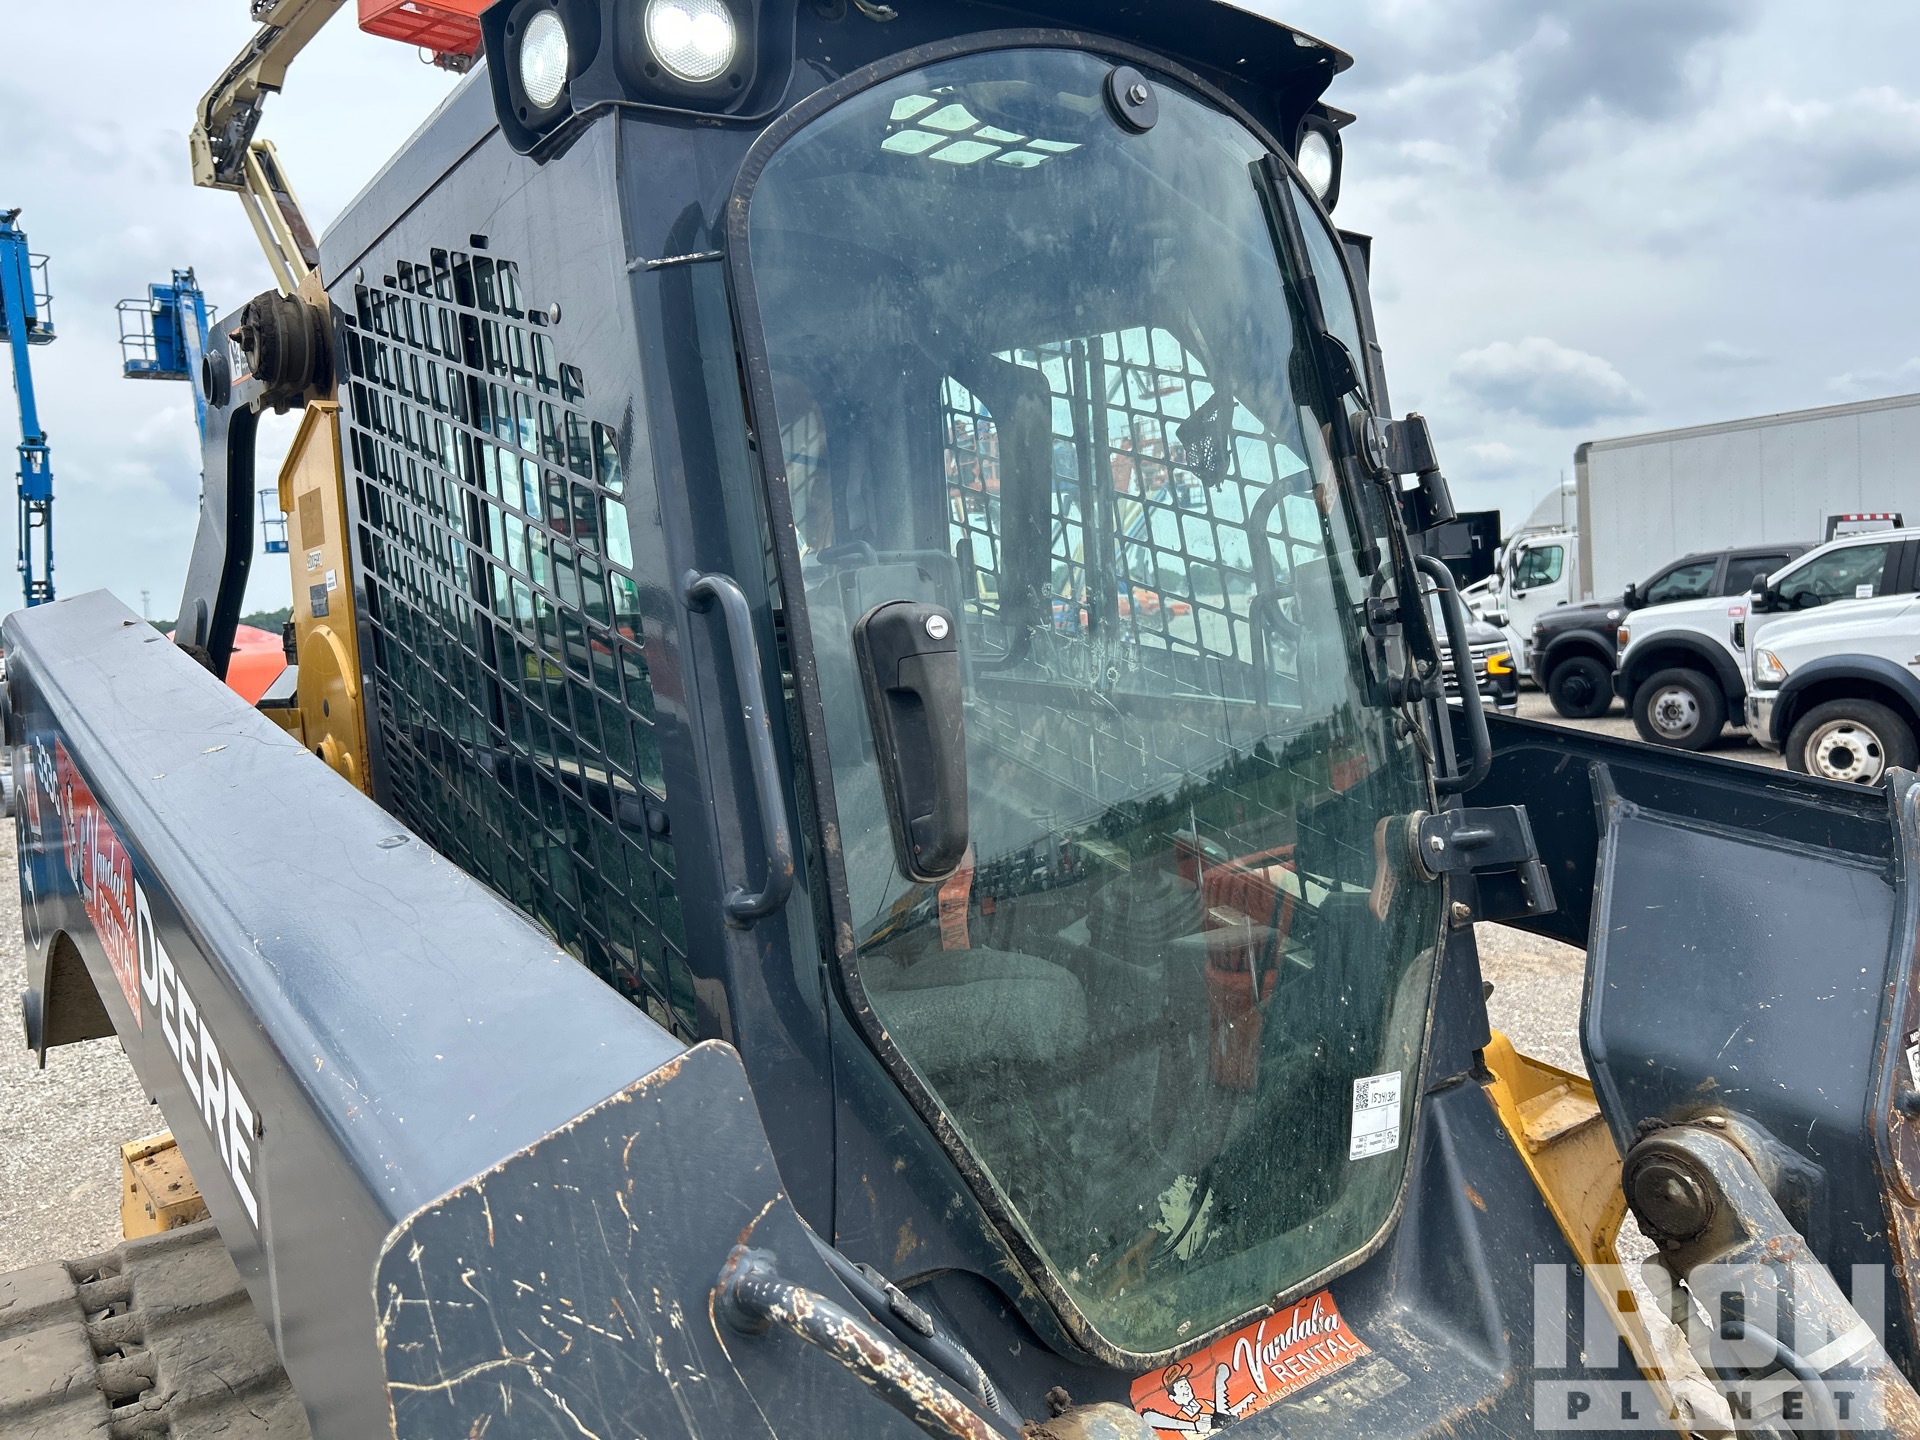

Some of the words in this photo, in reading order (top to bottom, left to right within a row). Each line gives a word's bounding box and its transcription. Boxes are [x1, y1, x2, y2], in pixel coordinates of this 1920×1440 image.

[86, 804, 135, 942] Vandalia
[99, 887, 139, 999] RENTAL
[134, 877, 259, 1229] DEERE
[1232, 1297, 1340, 1394] Vandalia
[1270, 1333, 1359, 1383] RENTAL
